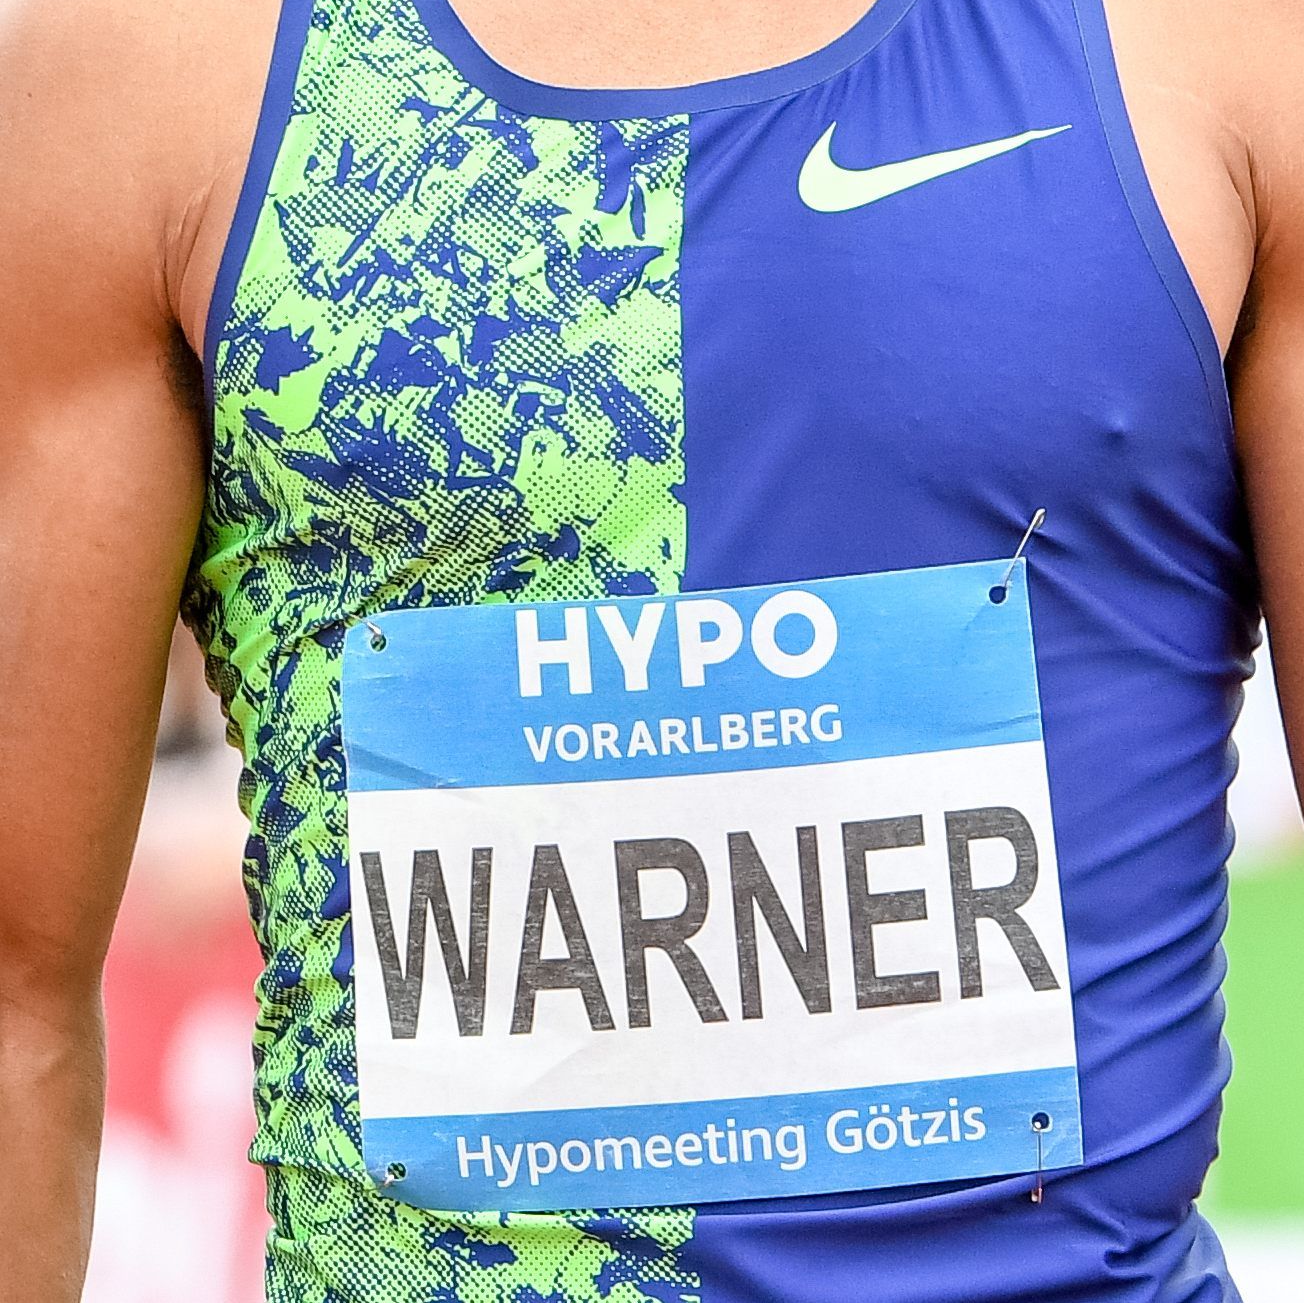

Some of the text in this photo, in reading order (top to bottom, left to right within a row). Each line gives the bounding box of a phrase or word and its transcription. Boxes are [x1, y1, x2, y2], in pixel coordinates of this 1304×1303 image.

[514, 589, 839, 697] HYPO
[523, 703, 845, 764] VORARLBERG
[359, 804, 1061, 1041] WARNER
[455, 1098, 987, 1188] Hypomeeting Götzis
